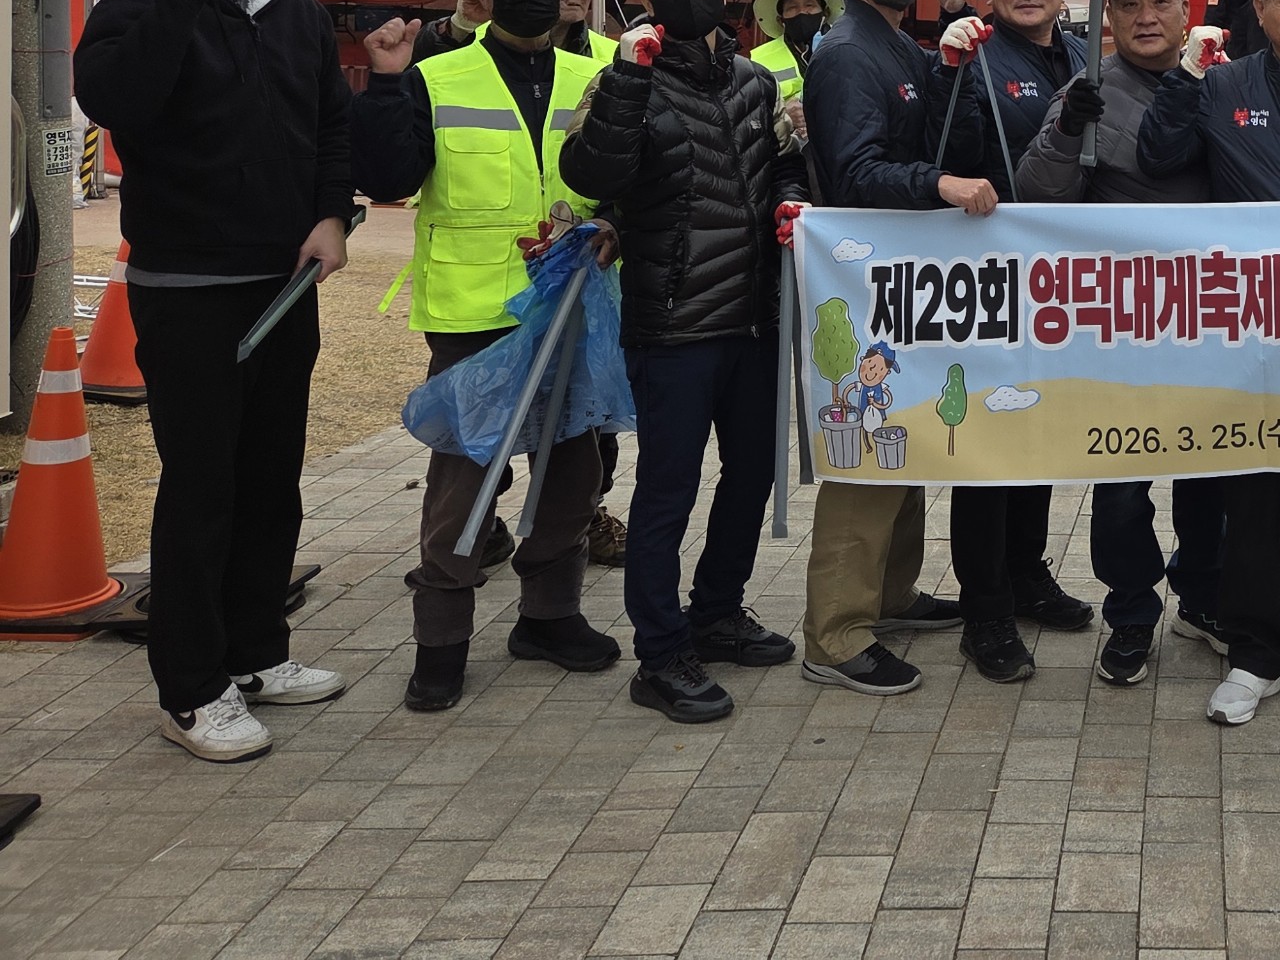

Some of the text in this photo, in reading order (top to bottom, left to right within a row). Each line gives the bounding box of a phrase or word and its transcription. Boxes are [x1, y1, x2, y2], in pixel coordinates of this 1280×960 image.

[870, 258, 1019, 345] 제29회
[1086, 427, 1168, 455] 2026.
[1176, 425, 1202, 452] 3.
